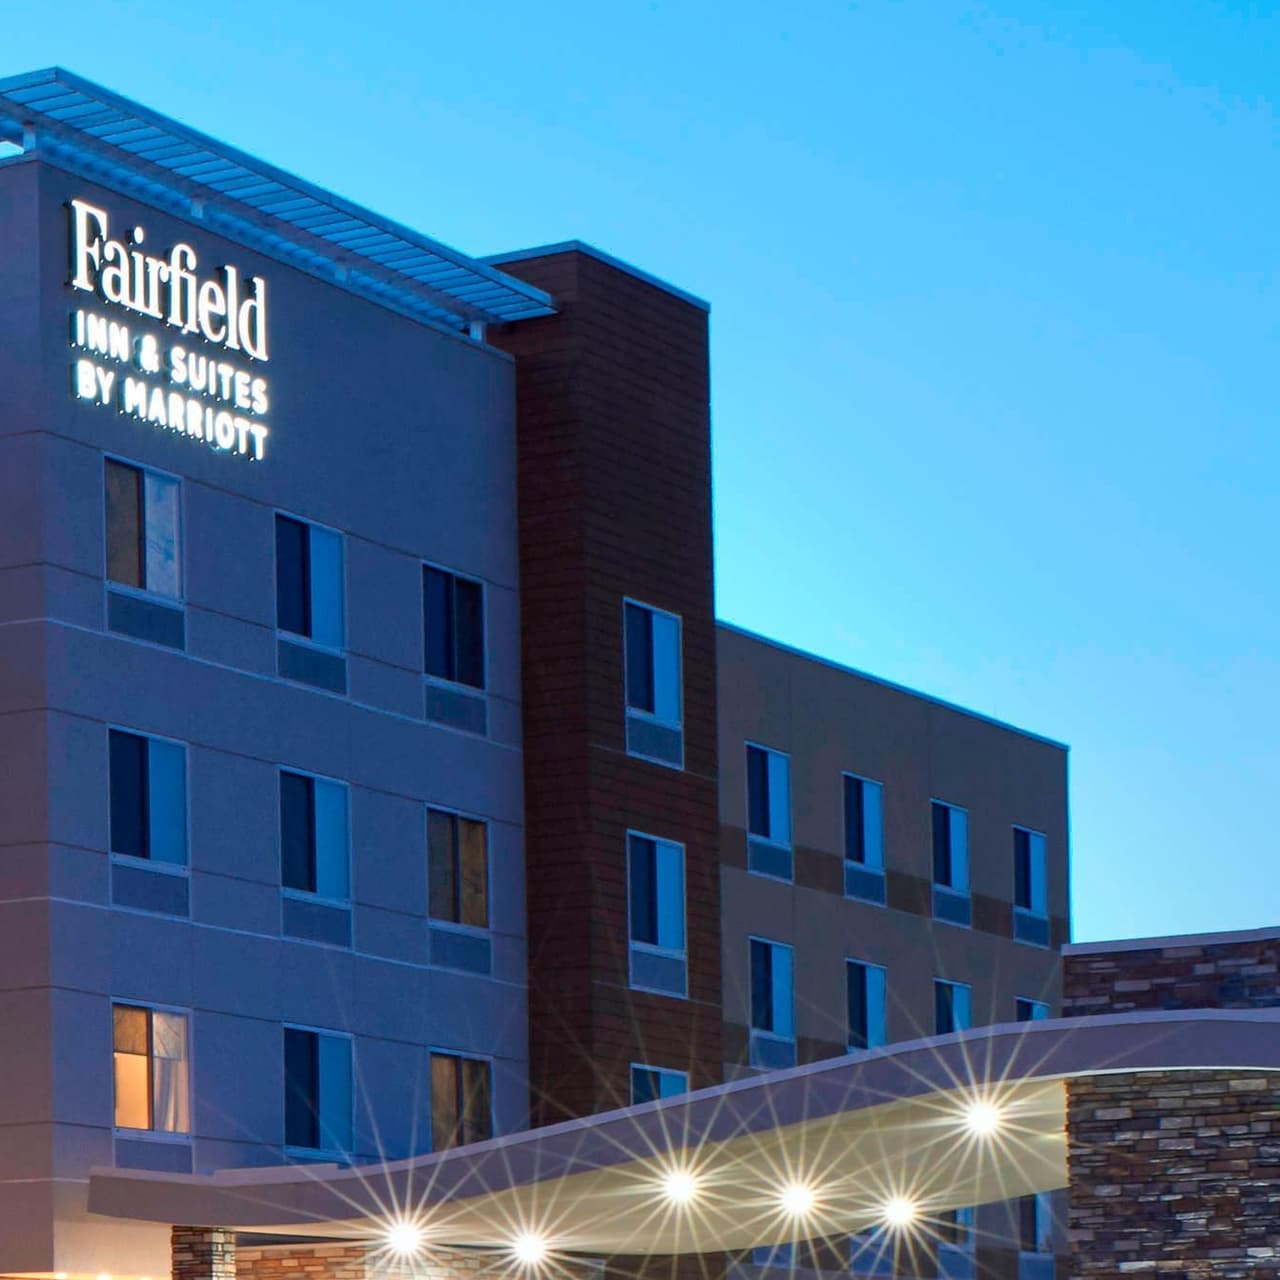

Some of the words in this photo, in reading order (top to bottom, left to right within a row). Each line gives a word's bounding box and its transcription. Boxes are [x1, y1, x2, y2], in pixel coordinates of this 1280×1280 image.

[70, 198, 269, 362] Fairfield
[76, 309, 130, 362] INN
[139, 334, 160, 374] &
[170, 345, 269, 416] SUITES
[76, 359, 115, 405] BY
[124, 376, 269, 461] MARRIOTT
